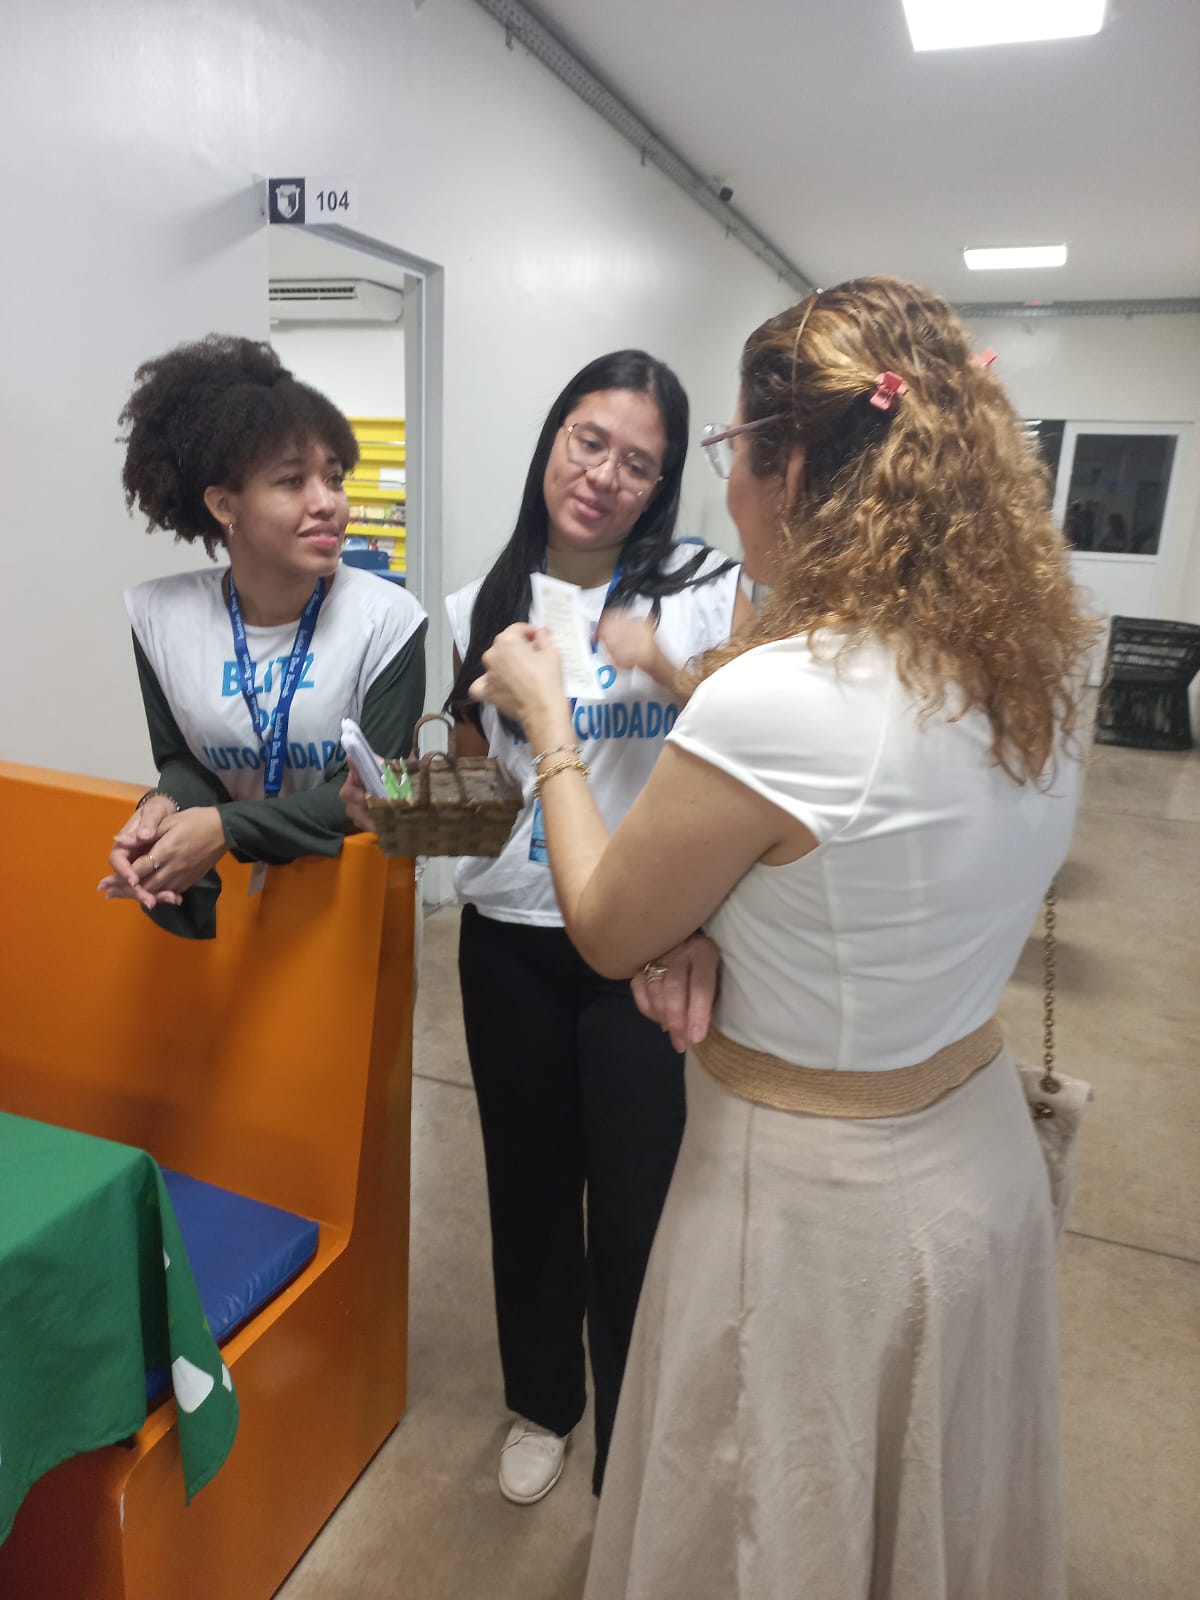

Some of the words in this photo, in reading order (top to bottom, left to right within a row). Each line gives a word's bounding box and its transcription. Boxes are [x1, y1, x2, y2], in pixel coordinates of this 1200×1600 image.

[316, 190, 350, 212] 104
[221, 652, 315, 697] BLITZ
[573, 701, 680, 741] CUIDADO
